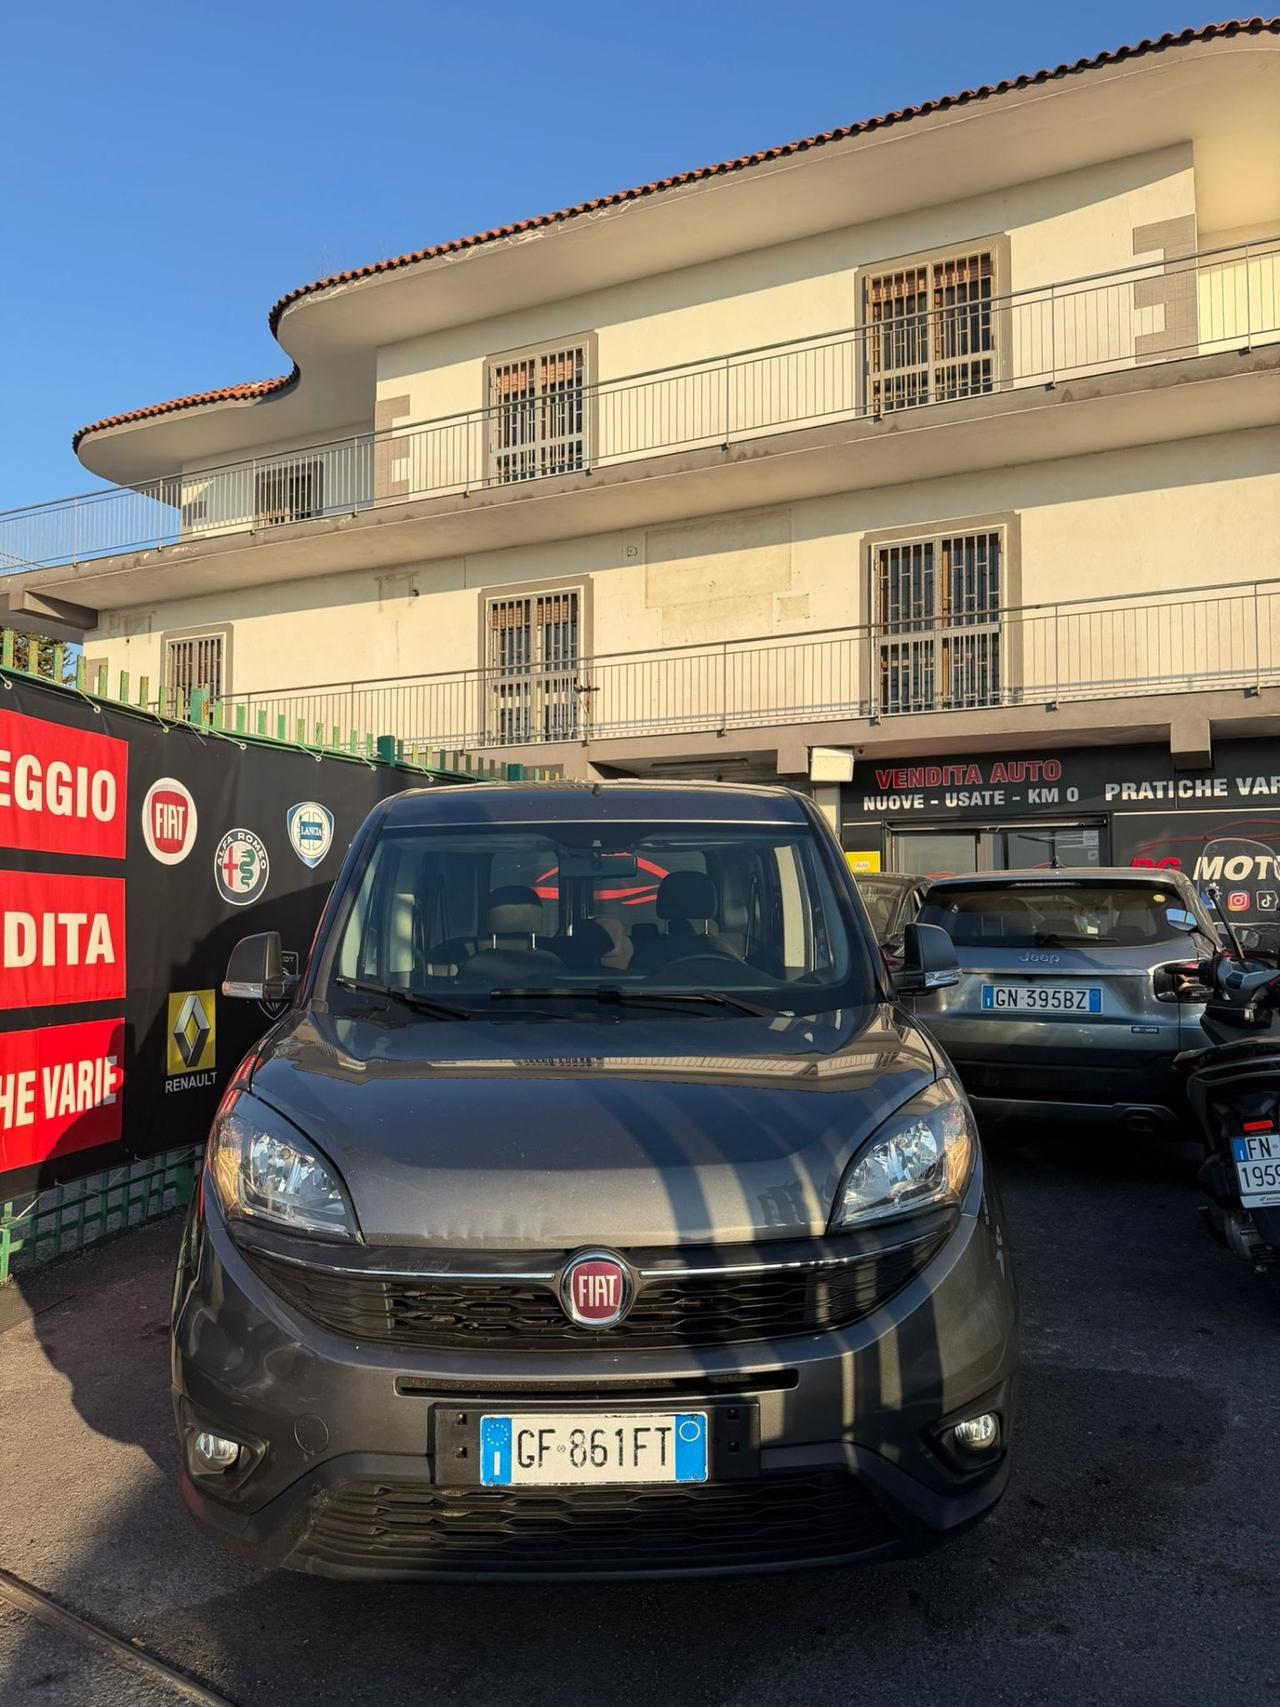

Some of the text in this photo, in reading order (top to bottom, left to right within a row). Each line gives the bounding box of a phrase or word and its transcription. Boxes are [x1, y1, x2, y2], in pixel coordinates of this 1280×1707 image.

[875, 759, 1062, 790] VENDITA AUTO
[863, 794, 924, 811] NUOVE
[945, 790, 1005, 808] USATE
[1028, 787, 1059, 804] KM
[1105, 778, 1228, 801] PRATICHE
[155, 802, 186, 841] FIAT
[300, 825, 322, 836] LANCIA
[217, 832, 267, 869] ALFA ROMEO
[1193, 855, 1280, 881] MOT
[4, 911, 116, 968] DITA
[1019, 951, 1060, 964] Jeep
[996, 989, 1018, 1008] GN
[1026, 989, 1087, 1010] 395BZ
[42, 1055, 117, 1120] VARIE
[165, 1071, 217, 1094] RENAULT
[1247, 1137, 1272, 1159] FN
[578, 1274, 618, 1307] FIAT
[517, 1429, 556, 1469] GF
[569, 1427, 673, 1468] 861FT
